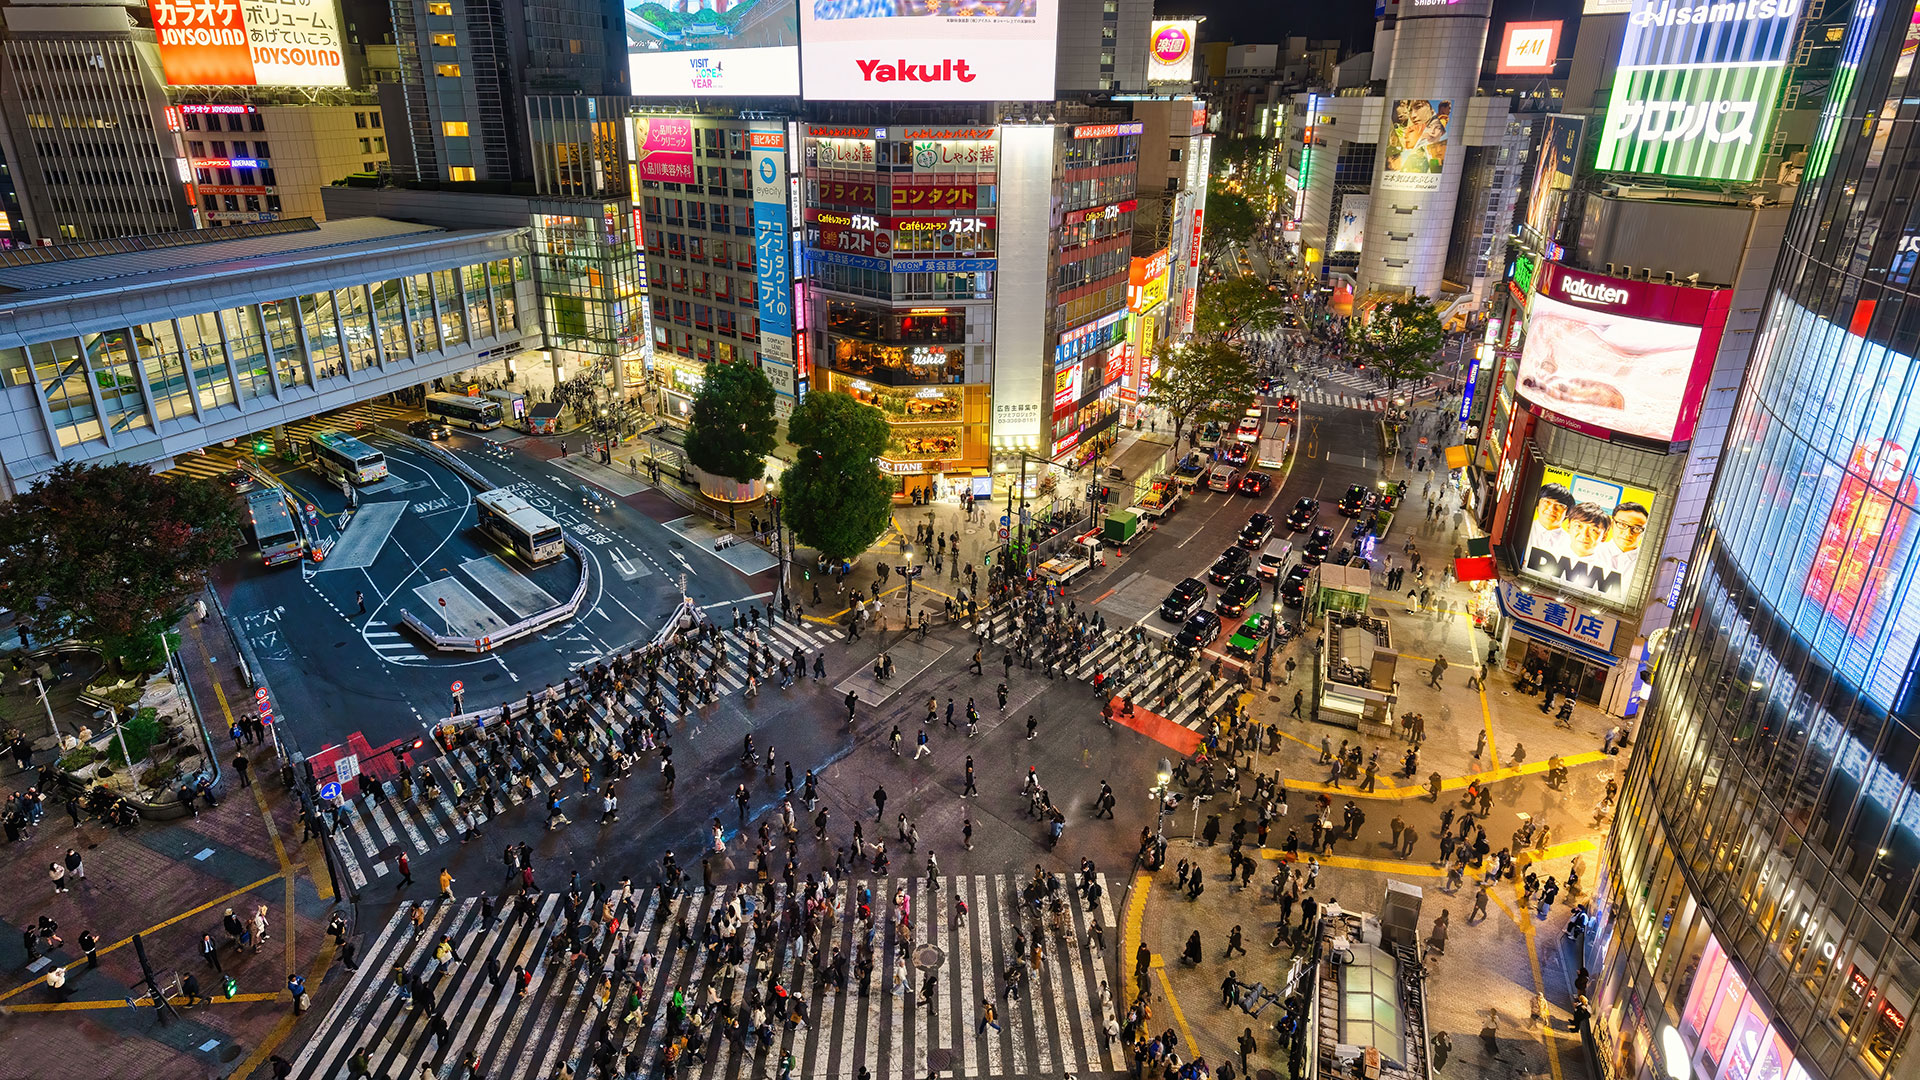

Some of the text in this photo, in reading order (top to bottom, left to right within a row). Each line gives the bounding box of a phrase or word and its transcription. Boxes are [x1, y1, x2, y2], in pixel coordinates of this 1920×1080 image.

[155, 1, 237, 26] カラオケ
[245, 5, 334, 30] ボリューム、
[162, 29, 245, 46] JOYSOUND
[250, 29, 338, 47] あげていこう。
[1156, 37, 1185, 53] 楽園
[1515, 39, 1545, 56] H&M
[253, 47, 340, 66] JOYSOUND
[690, 58, 709, 68] VISIT
[696, 68, 723, 78] KOREA
[856, 59, 977, 83] Yakult
[691, 79, 713, 88] YEAR
[660, 124, 689, 136] 品川スキン
[1616, 100, 1758, 145] サロンパス
[661, 136, 687, 148] クリニック
[904, 128, 994, 139] しゃぶしゃぶバイキング
[806, 147, 816, 157] 9F
[837, 145, 873, 163] しゃぶ葉
[942, 146, 995, 163] しゃぶ葉
[647, 162, 691, 177] 品川美容外科
[757, 186, 783, 199] eyecity
[820, 184, 874, 201] プライス
[892, 189, 974, 203] コンタクト
[852, 214, 879, 231] ガスト
[949, 218, 987, 232] ガスト
[808, 229, 820, 241] 7F
[839, 231, 871, 252] ガスト
[758, 220, 775, 313] アイシティ
[827, 252, 876, 268] 英会話イーオン
[926, 260, 995, 270] 英会話イーオン
[773, 222, 787, 316] コンタクトの
[1561, 275, 1629, 304] Rakuten
[912, 353, 947, 365] Ushi8
[1100, 382, 1119, 400] LUSH
[1527, 546, 1621, 593] DMM
